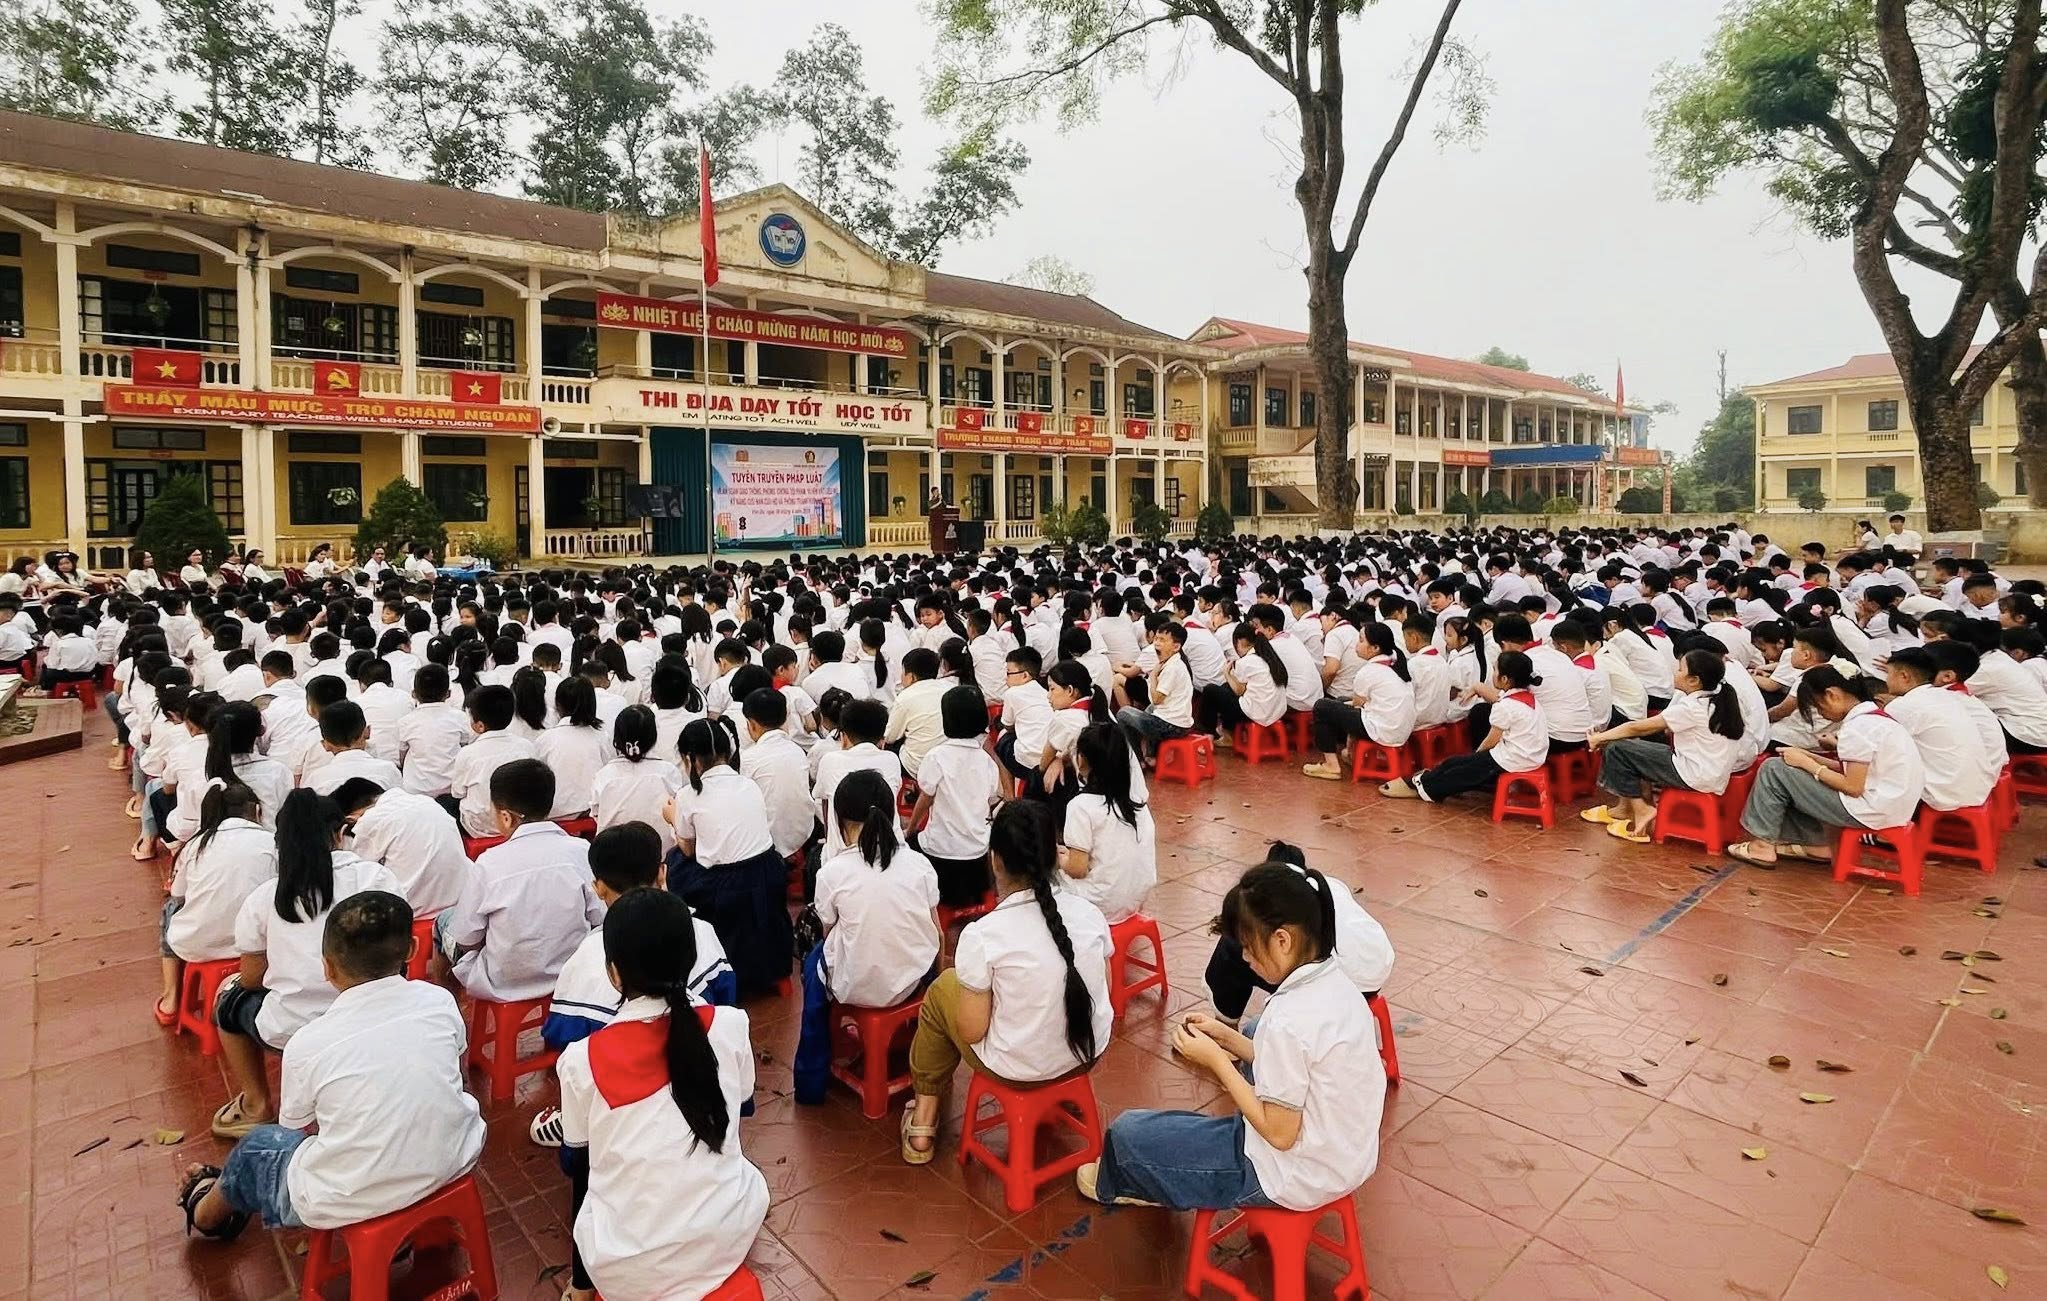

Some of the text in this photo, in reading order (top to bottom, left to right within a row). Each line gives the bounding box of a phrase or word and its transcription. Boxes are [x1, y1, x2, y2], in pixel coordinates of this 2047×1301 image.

[633, 305, 678, 328] NHIỆT
[757, 318, 797, 339] MỪNG
[800, 325, 830, 343] NĂM
[833, 331, 858, 348] HỌC
[860, 331, 883, 349] MỚI
[343, 401, 385, 416] TRÒ
[464, 409, 532, 423] NGOAN
[639, 390, 912, 422] THI ĐUA DẠY TỐT HỌC TỐT
[379, 417, 435, 426] BEHAVED
[436, 419, 494, 428] STUDENTS
